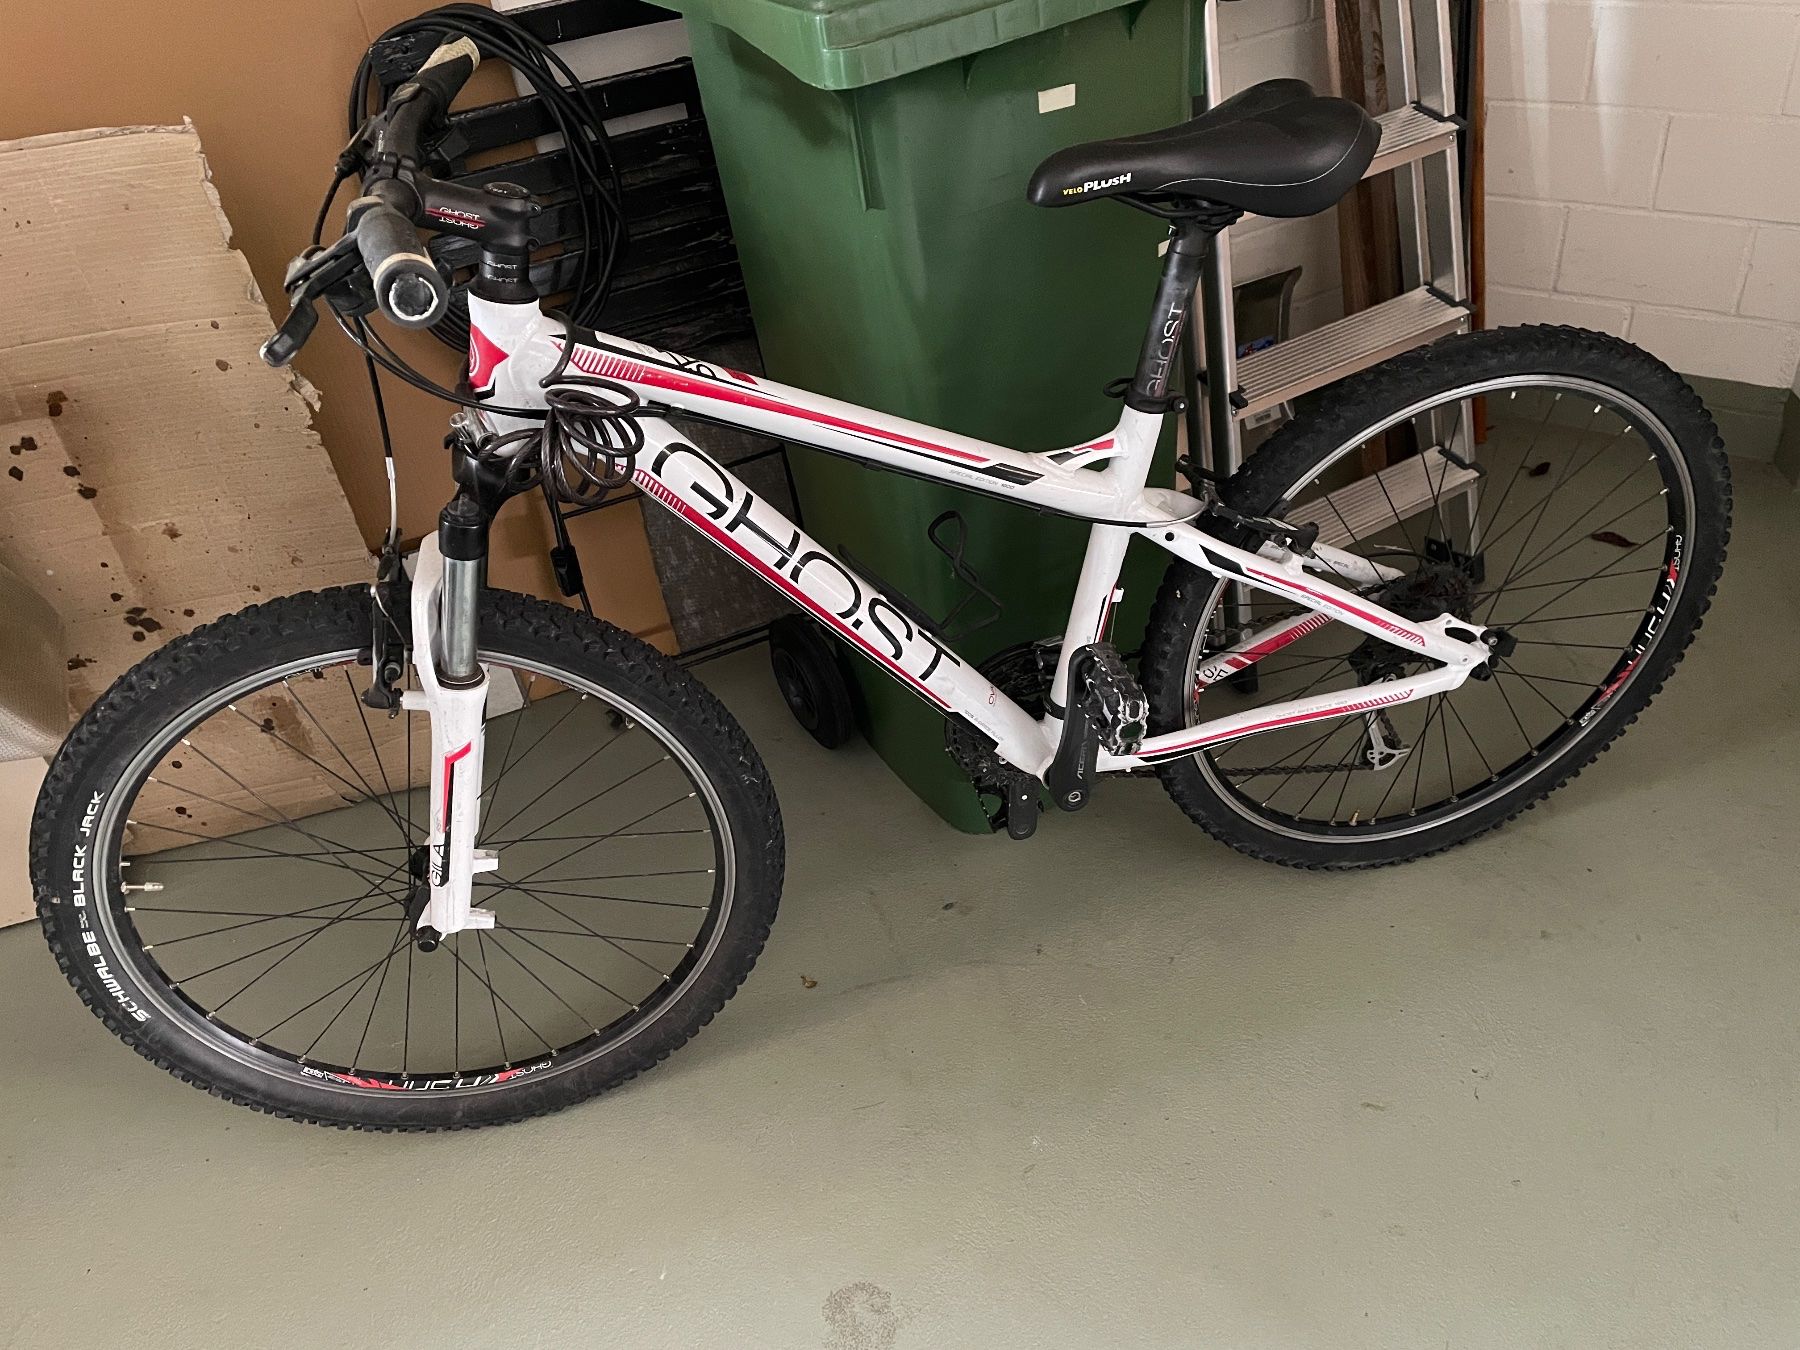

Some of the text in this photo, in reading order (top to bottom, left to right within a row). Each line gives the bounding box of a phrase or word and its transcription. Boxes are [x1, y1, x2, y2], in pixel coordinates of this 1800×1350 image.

[440, 206, 480, 221] GHOST
[1063, 172, 1132, 196] VELO PLUSH
[651, 441, 961, 682] GHOST
[72, 790, 152, 1022] SCHWALBE BLACK JACK
